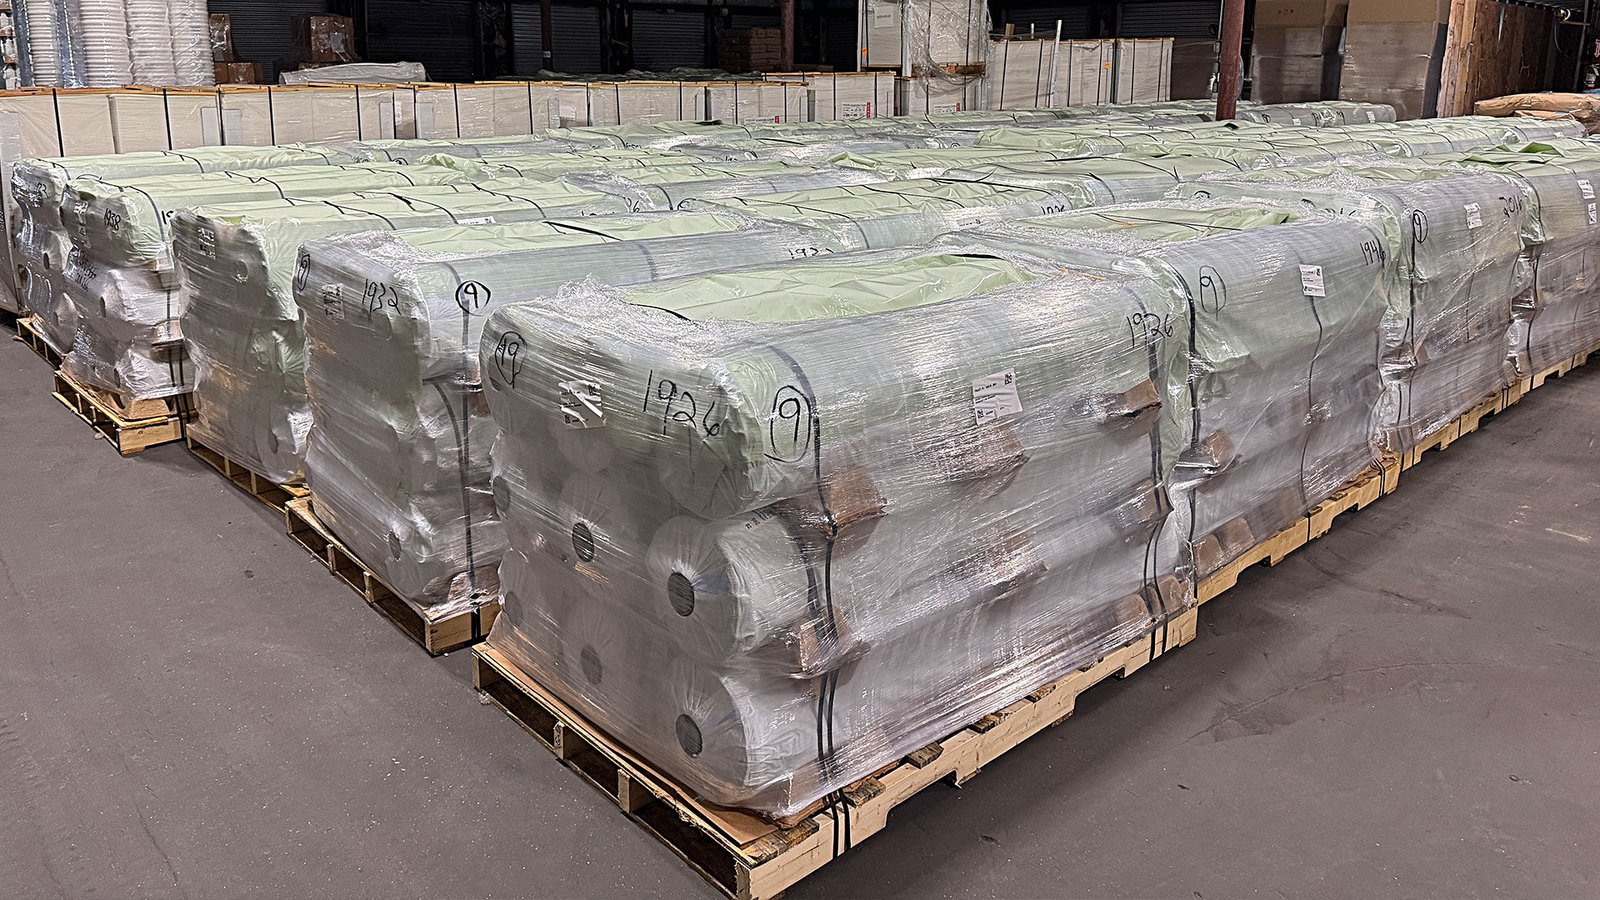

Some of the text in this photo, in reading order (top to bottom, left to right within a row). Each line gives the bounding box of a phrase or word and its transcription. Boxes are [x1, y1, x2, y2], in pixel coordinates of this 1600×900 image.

[362, 279, 401, 315] 1932
[1126, 312, 1173, 351] 1926
[643, 369, 722, 437] 1926
